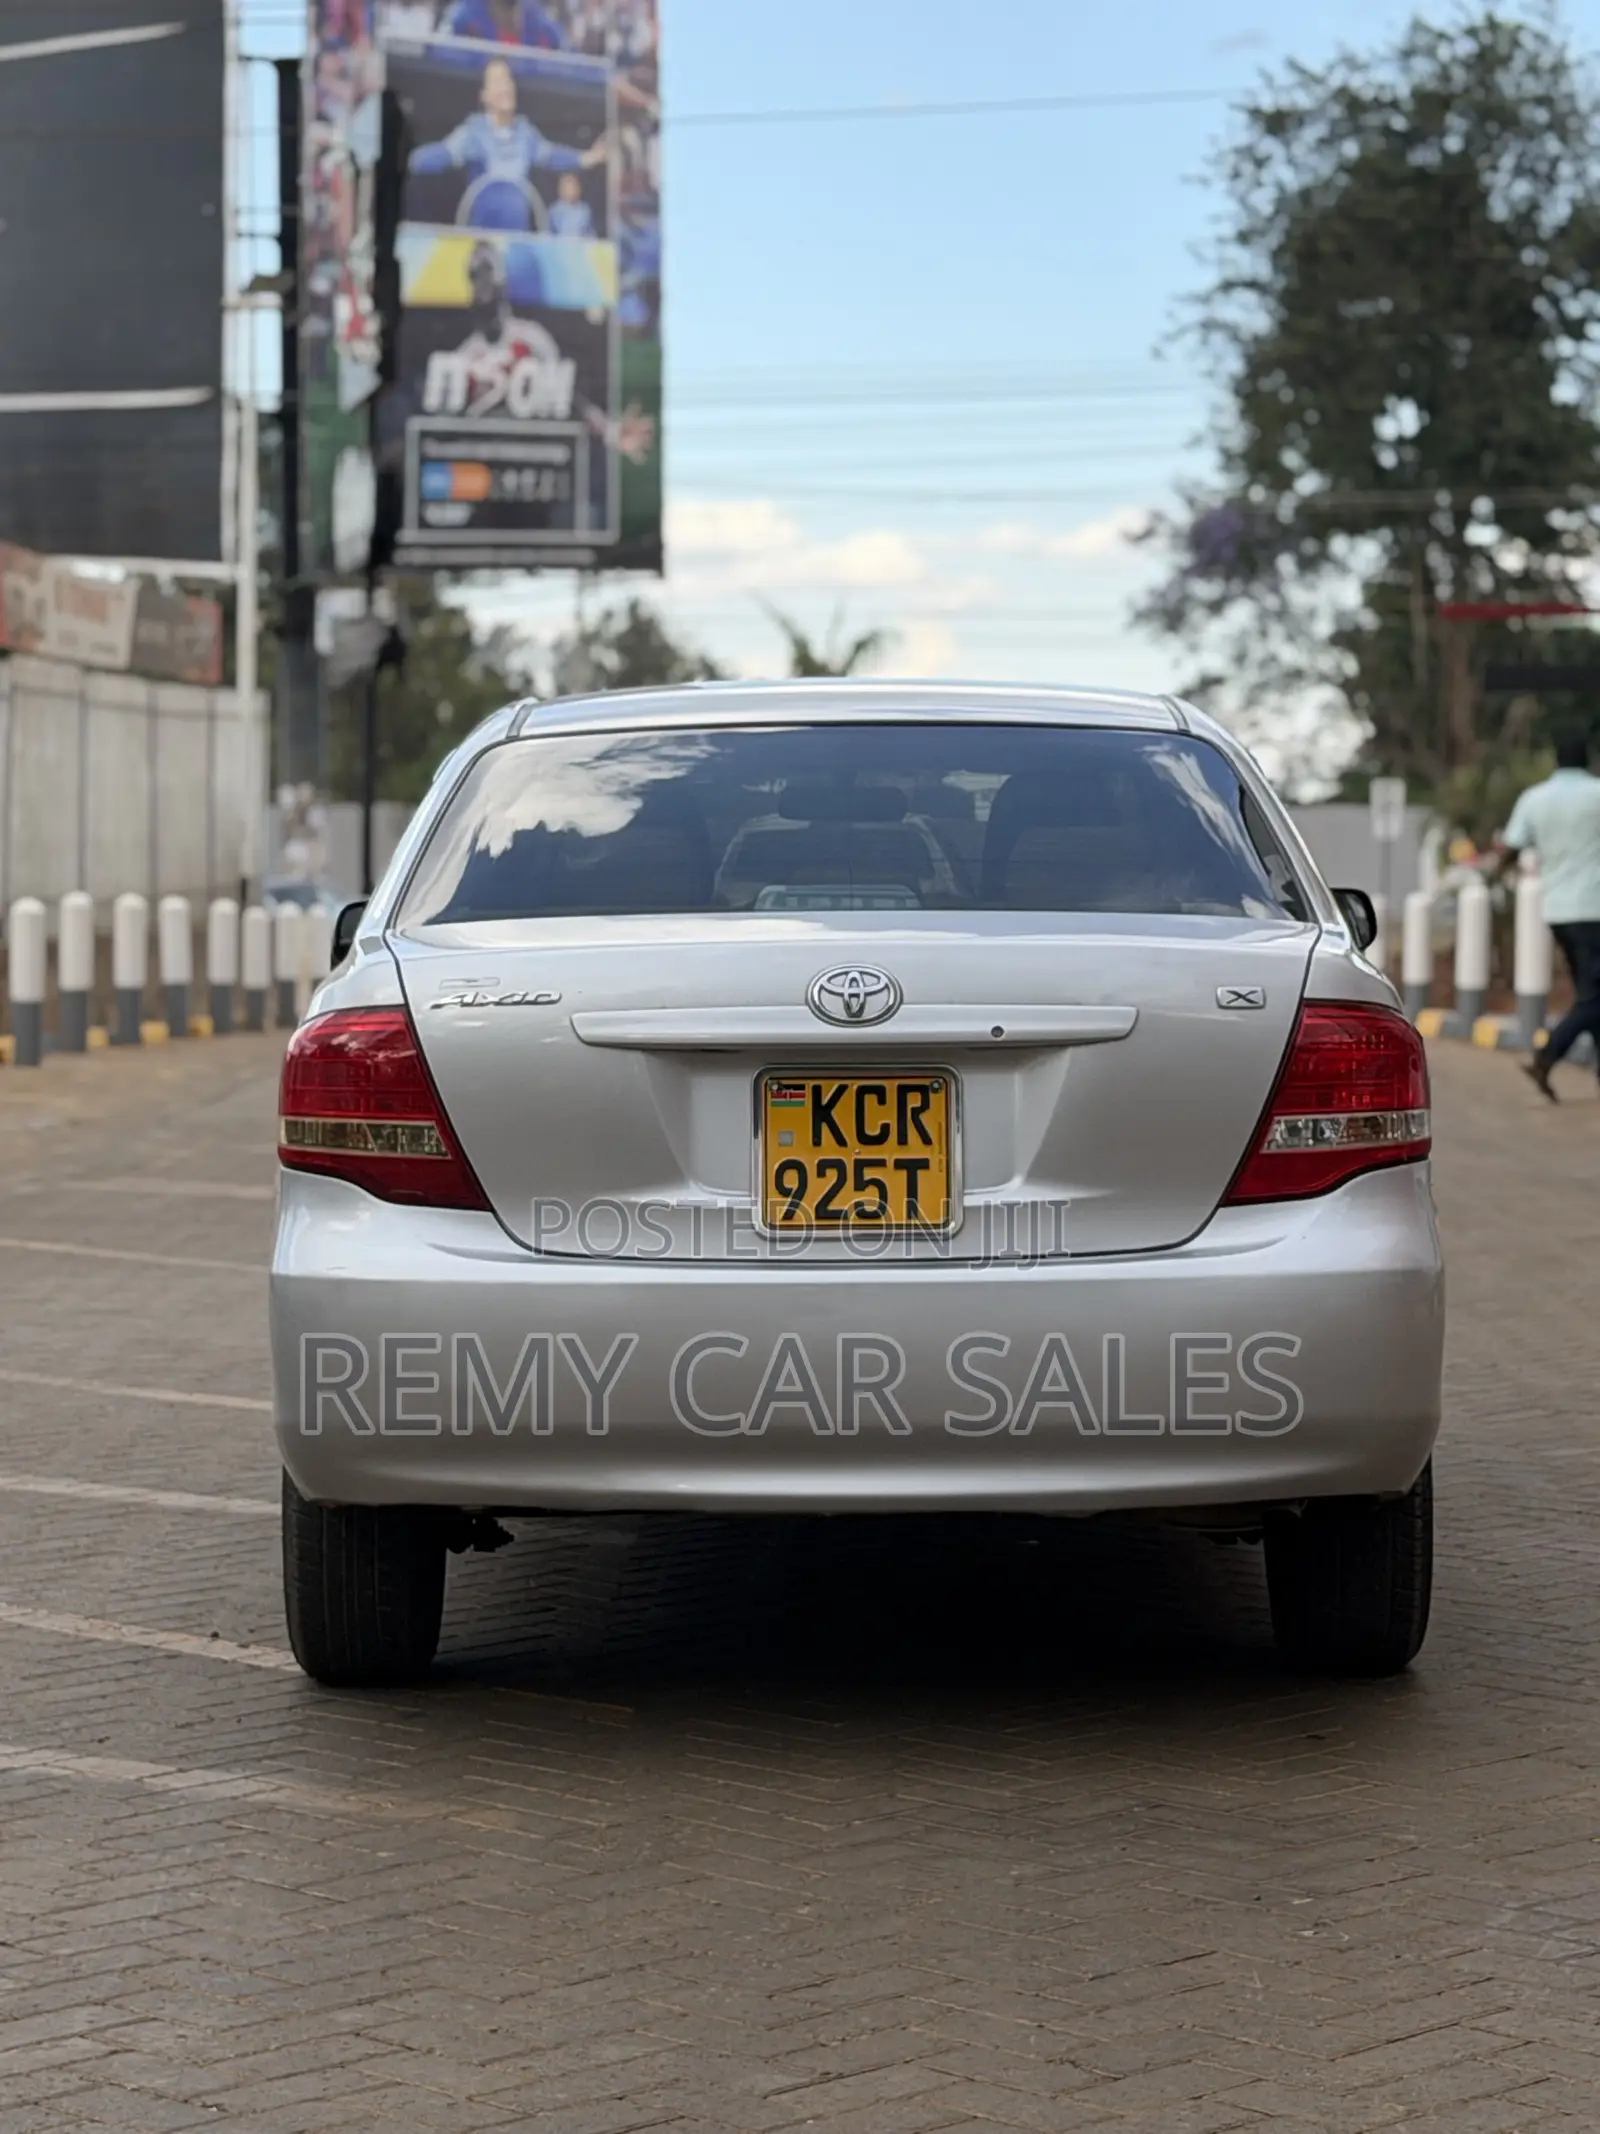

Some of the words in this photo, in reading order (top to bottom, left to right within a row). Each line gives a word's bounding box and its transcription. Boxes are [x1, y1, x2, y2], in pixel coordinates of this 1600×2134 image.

[1225, 989, 1260, 1005] X
[811, 1084, 933, 1147] KCR
[774, 1159, 930, 1220] 925T
